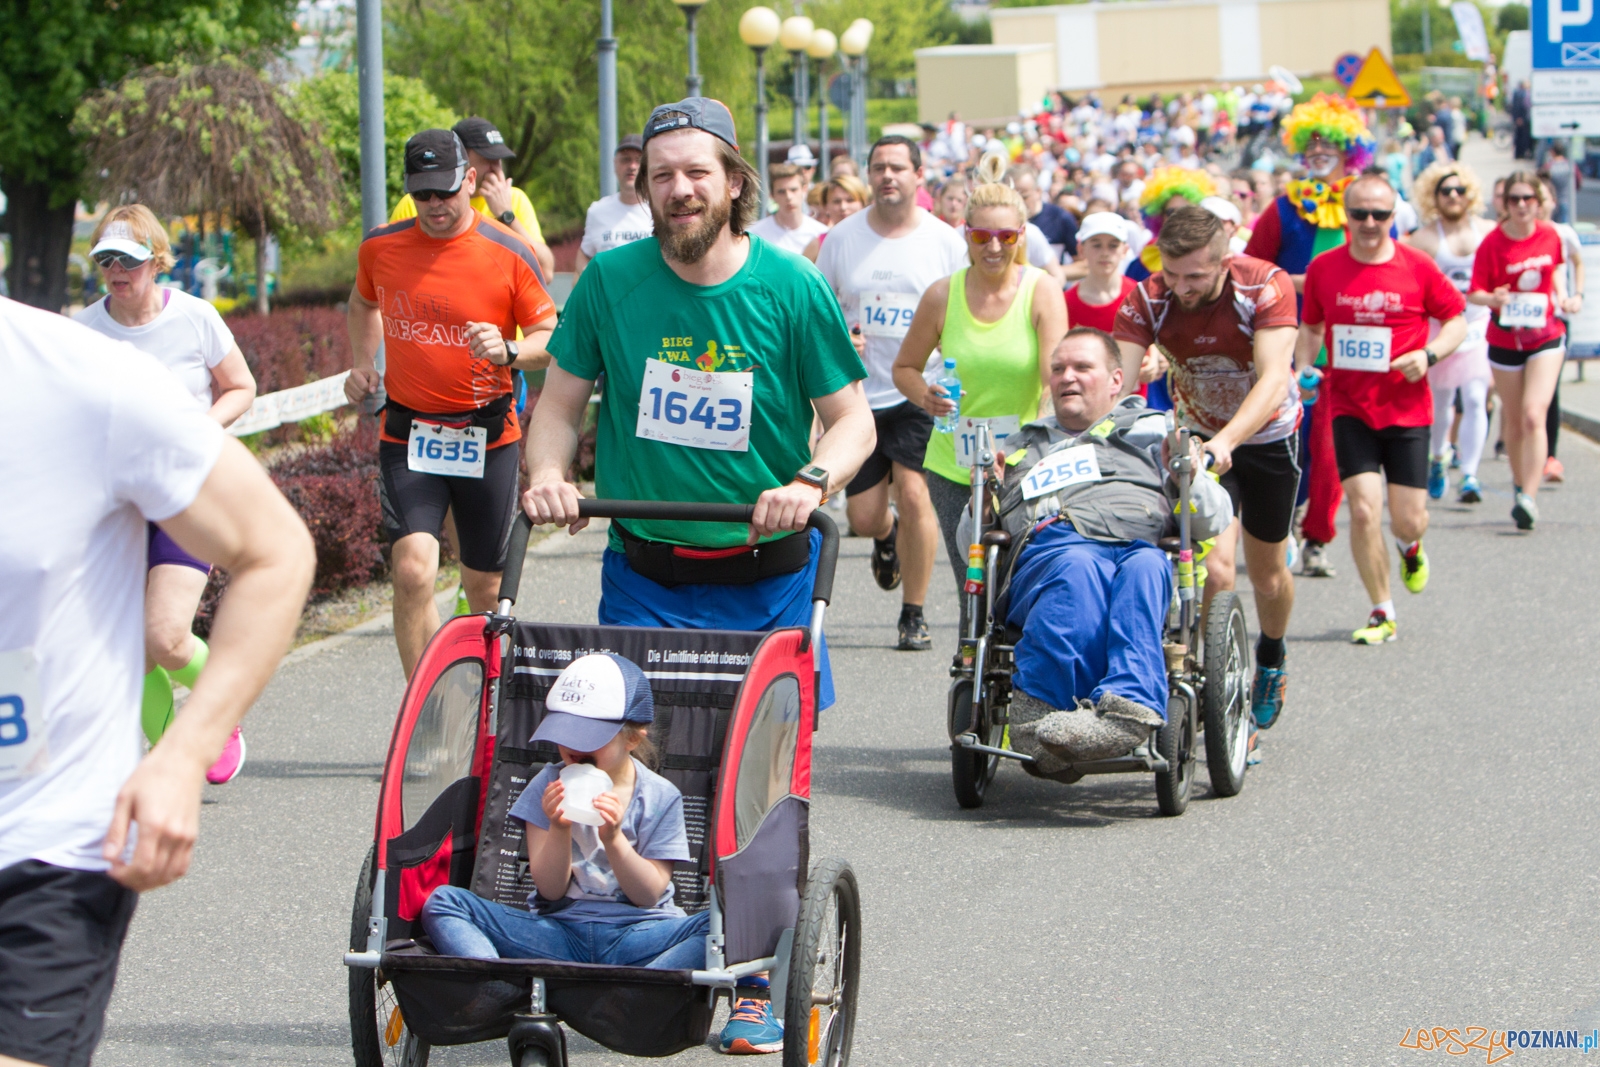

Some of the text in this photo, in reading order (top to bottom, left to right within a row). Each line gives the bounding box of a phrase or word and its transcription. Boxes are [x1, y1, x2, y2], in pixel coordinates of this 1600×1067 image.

[1548, 0, 1593, 43] P
[864, 306, 914, 326] 1479
[384, 316, 470, 347] BECAU
[661, 336, 693, 347] BIEG
[1338, 339, 1384, 359] 1683
[658, 351, 690, 363] LWA
[683, 370, 703, 385] bieg
[649, 387, 742, 432] 1643
[415, 436, 478, 463] 1635
[1027, 459, 1093, 490] 1256
[523, 646, 536, 658] not
[539, 648, 572, 663] overpass
[647, 649, 660, 663] Die
[663, 650, 699, 663] Limitlinie
[699, 650, 719, 664] nicht
[561, 691, 586, 705] GO!
[500, 849, 519, 857] Pre-R
